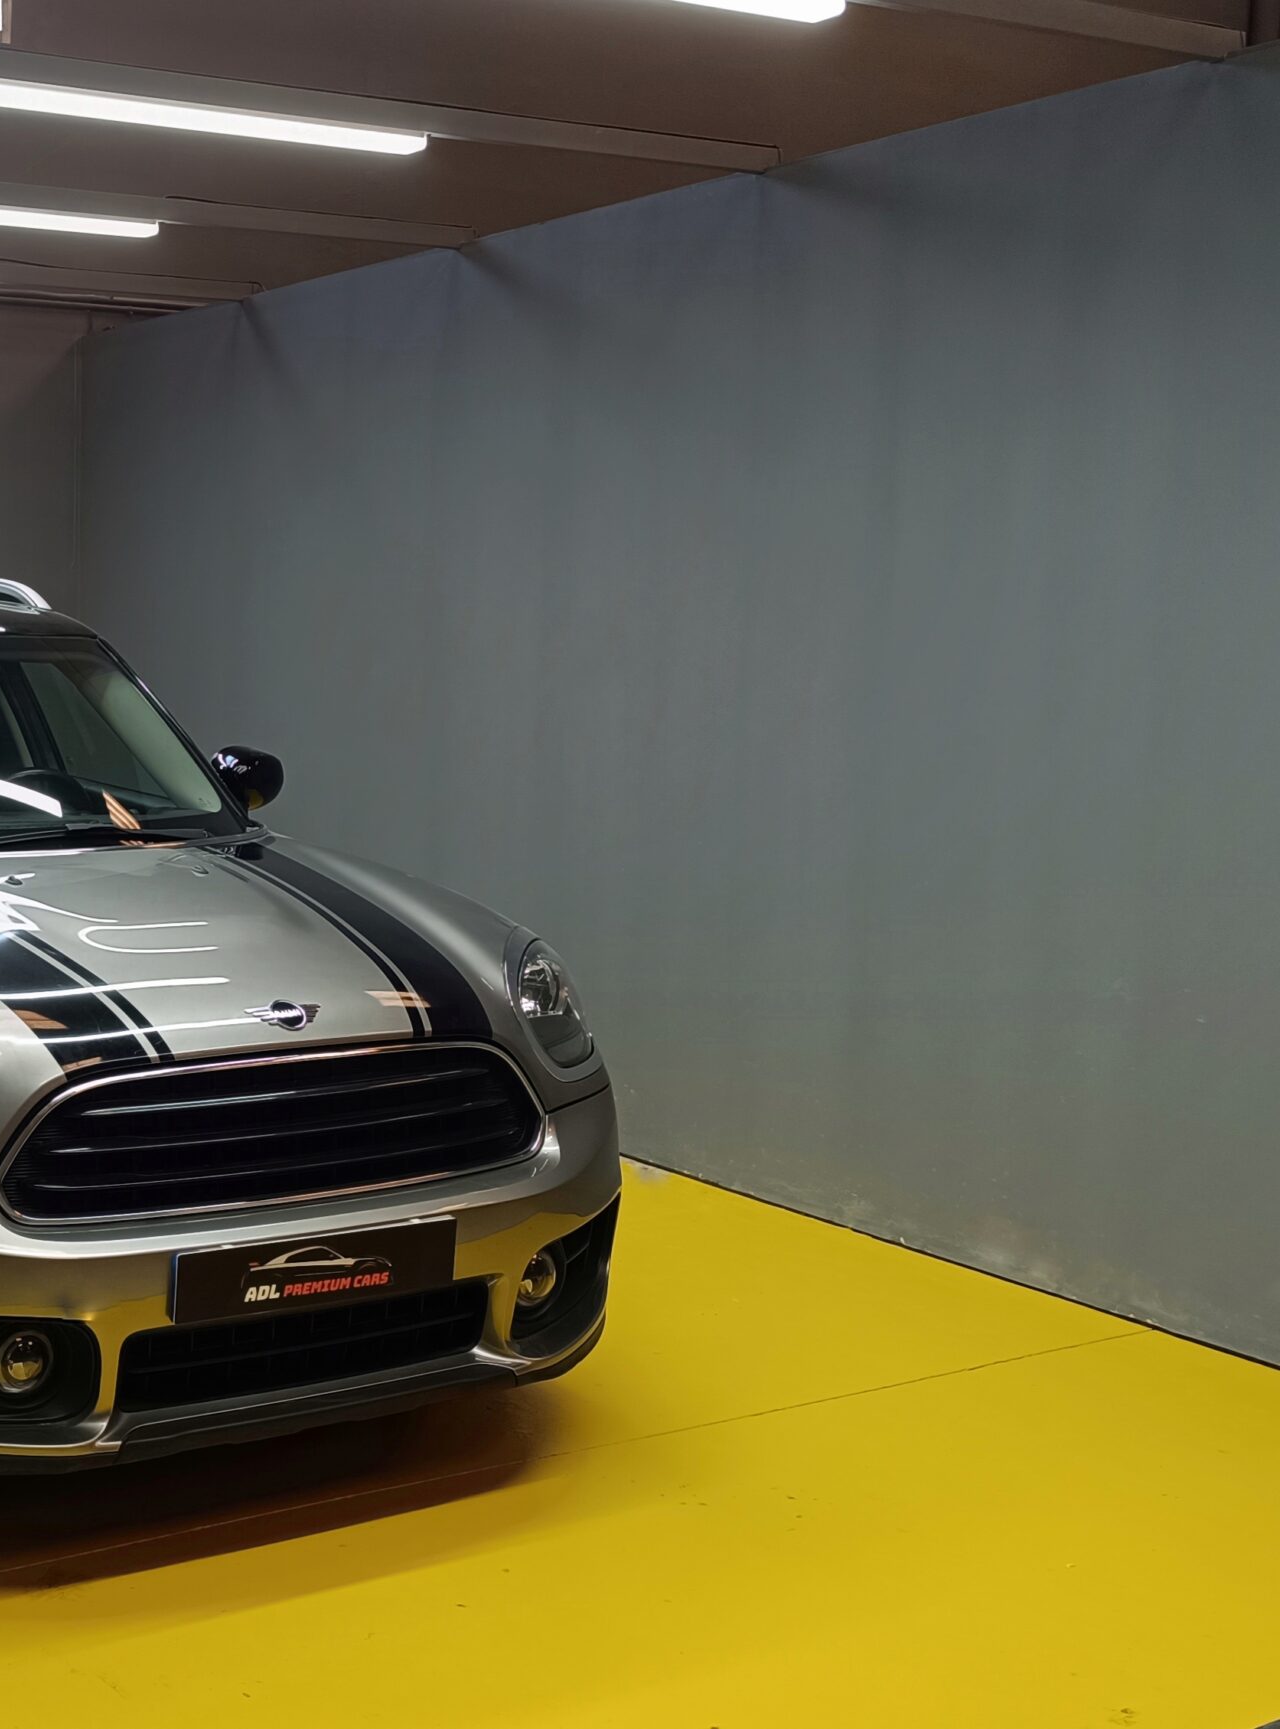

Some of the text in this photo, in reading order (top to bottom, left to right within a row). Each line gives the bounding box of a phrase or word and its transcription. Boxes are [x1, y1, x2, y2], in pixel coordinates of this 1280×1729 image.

[244, 1272, 389, 1303] ADL PREMIUM CARS
